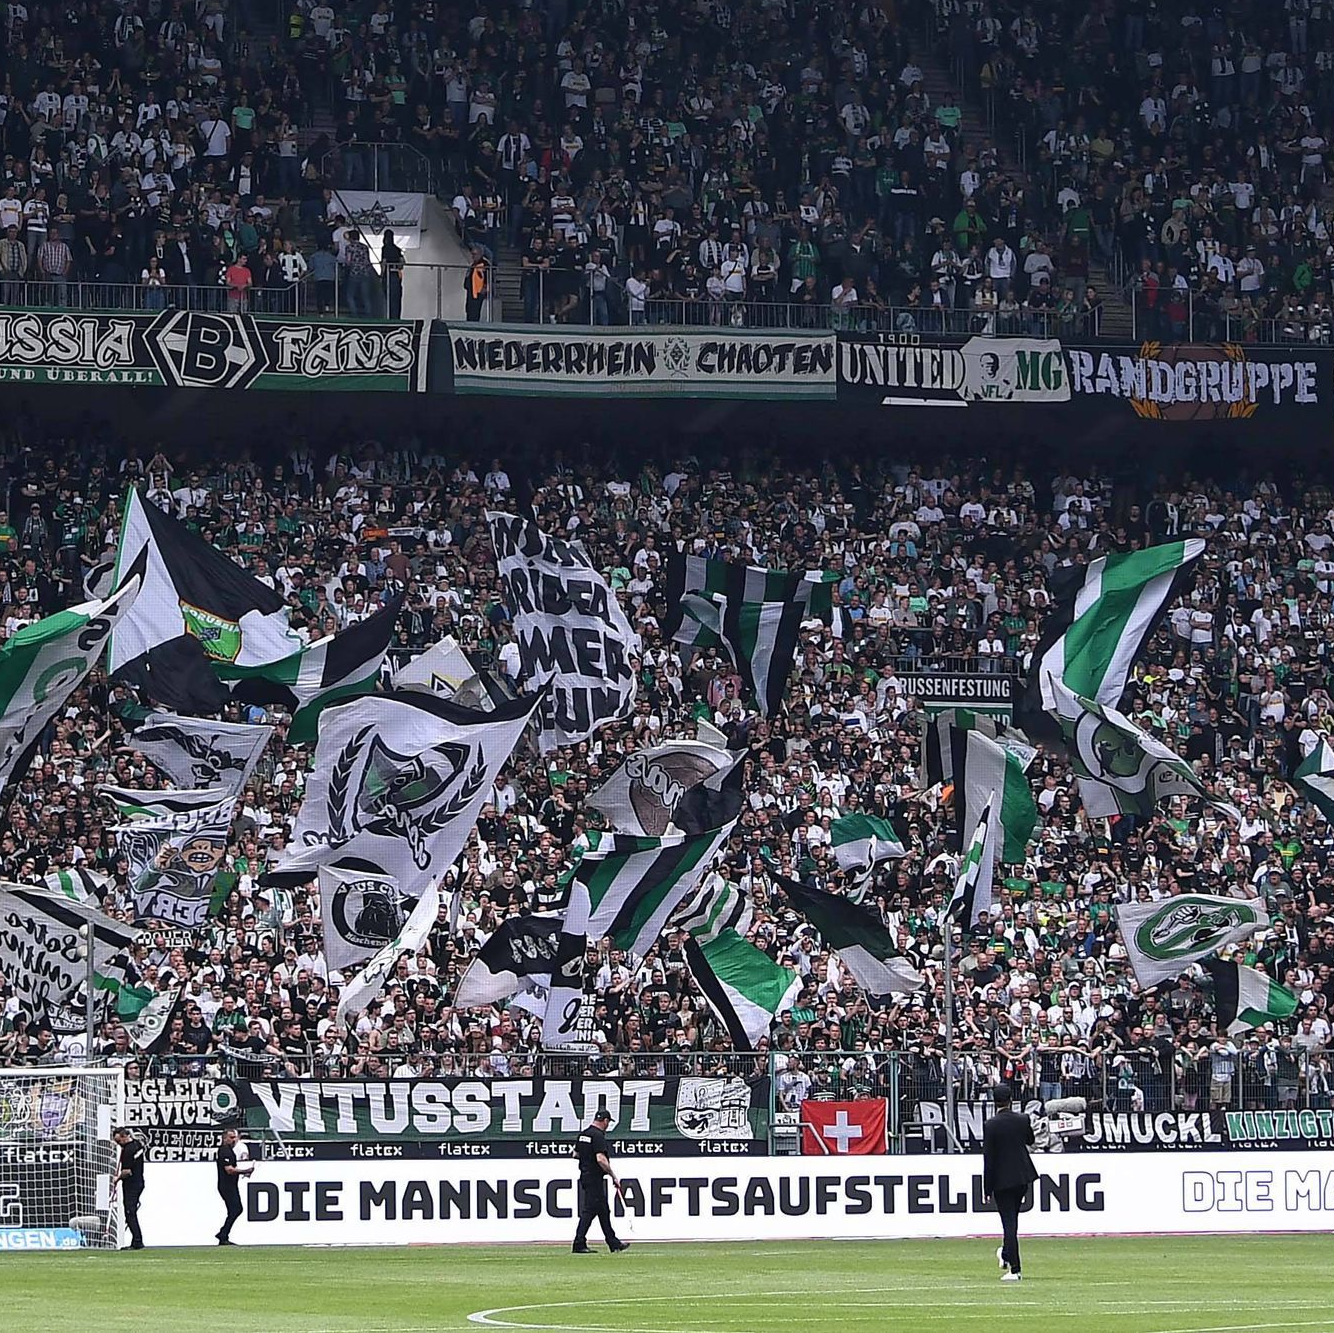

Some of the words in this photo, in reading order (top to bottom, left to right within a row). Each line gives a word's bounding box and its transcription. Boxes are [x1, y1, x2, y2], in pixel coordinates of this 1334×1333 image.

[275, 325, 415, 374] FANS
[452, 335, 656, 376] NIEDERRHEIN
[696, 338, 833, 375] CHAOTEN
[45, 369, 153, 386] ÜBERALL!
[838, 344, 965, 391] UNITED
[1015, 346, 1065, 393] MG
[1067, 354, 1318, 407] RANDGRUPPE
[899, 677, 1010, 699] RUSSENFESTUNG
[249, 1079, 666, 1139] VITUSSTADT
[2, 1147, 73, 1164] flatex
[351, 1142, 403, 1157] flatex
[438, 1142, 491, 1156] flatex
[525, 1141, 576, 1155] flatex
[612, 1141, 664, 1155] flatex
[699, 1140, 749, 1154] flatex
[247, 1181, 351, 1222] DIE
[1181, 1170, 1275, 1213] DIE
